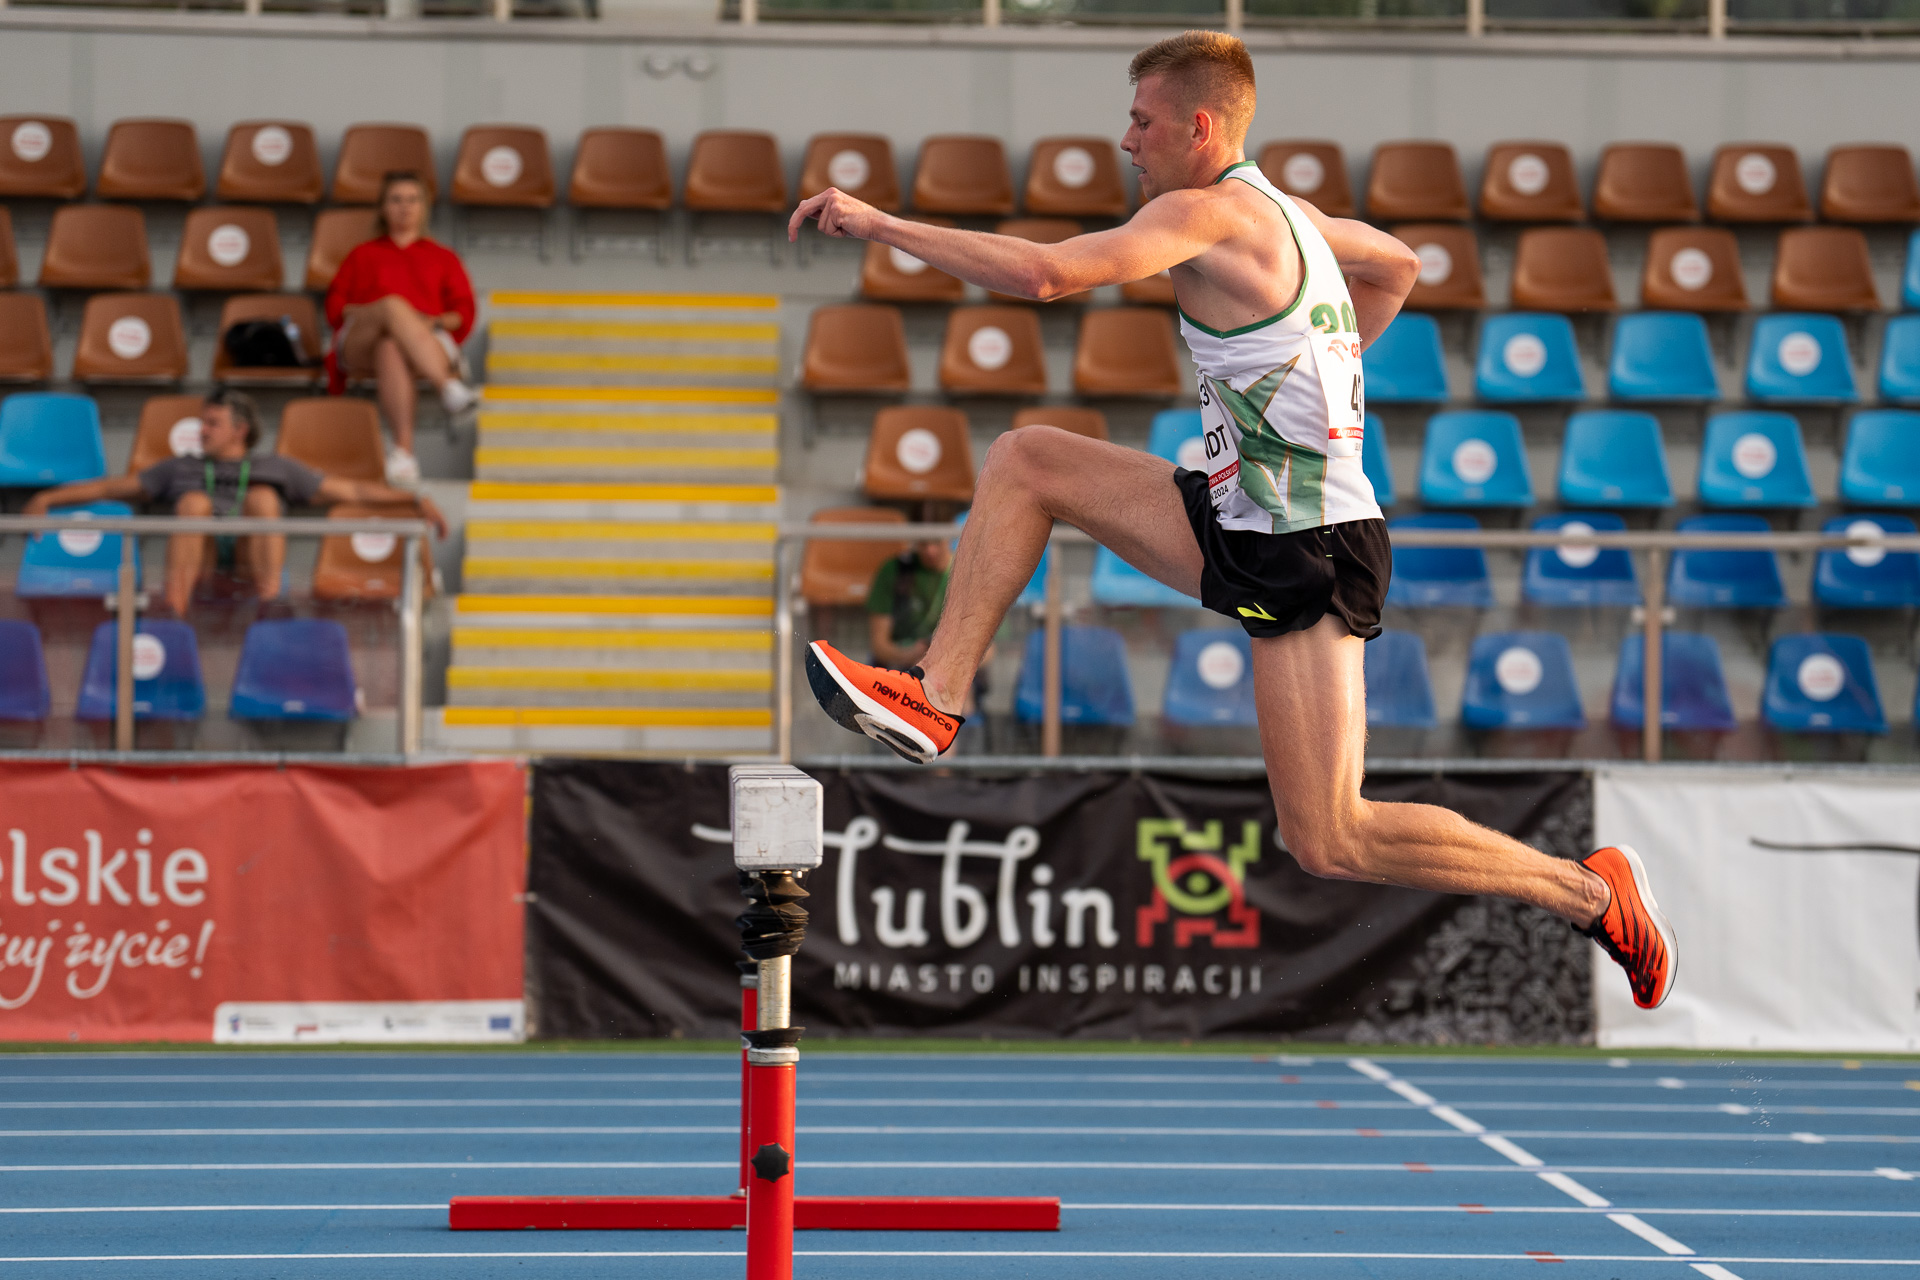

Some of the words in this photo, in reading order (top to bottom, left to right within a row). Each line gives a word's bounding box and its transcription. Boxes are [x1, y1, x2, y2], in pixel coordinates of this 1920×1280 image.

[1200, 383, 1210, 409] 3
[1213, 484, 1229, 500] 2024
[872, 680, 900, 701] new
[900, 693, 953, 731] balance
[0, 827, 209, 906] lskie
[64, 919, 215, 1000] życie!
[833, 961, 995, 994] MIASTO
[1018, 963, 1262, 999] INSPIRACJI
